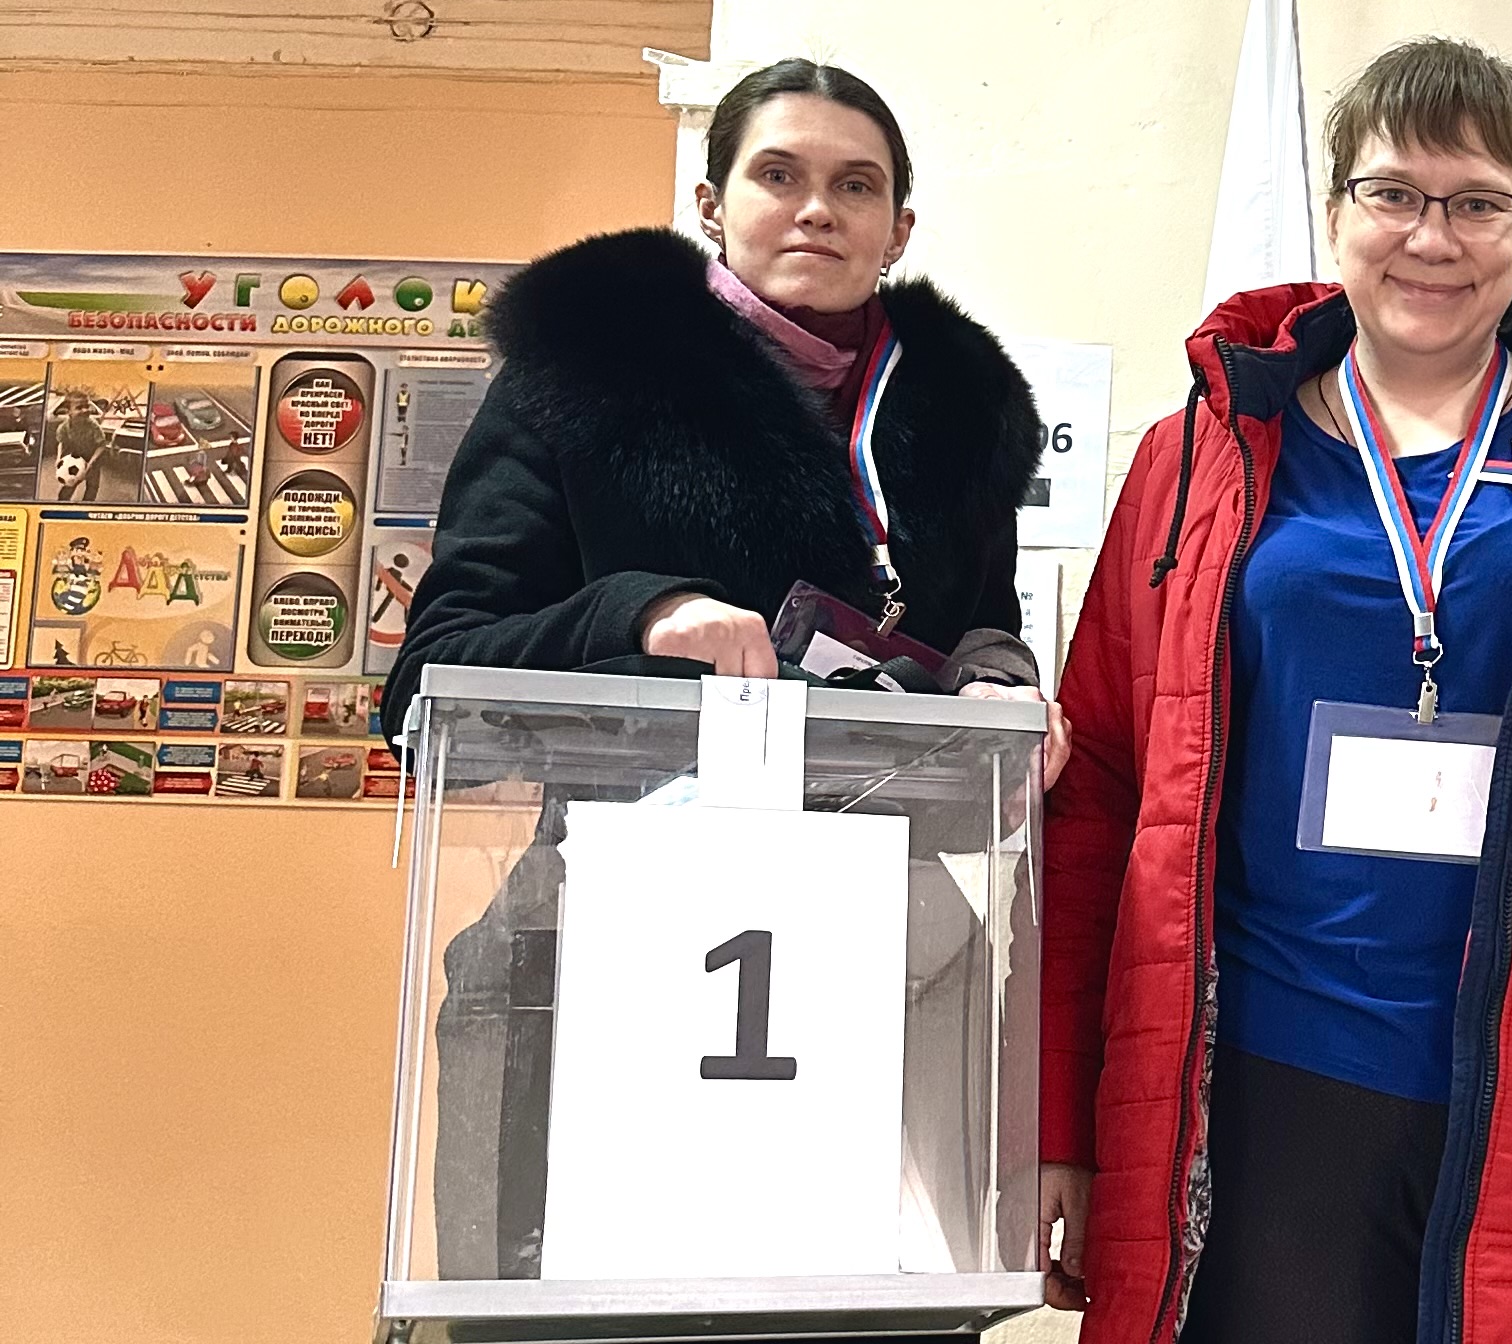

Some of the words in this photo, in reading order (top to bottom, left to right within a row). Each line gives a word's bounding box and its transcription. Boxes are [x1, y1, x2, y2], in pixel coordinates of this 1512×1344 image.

[178, 270, 488, 315] УГОЛОК
[67, 310, 257, 332] БЕЗОПАСНОСТИ
[271, 315, 434, 336] ДОРОЖНОГО
[304, 420, 334, 429] ДОРОГИ
[303, 432, 334, 446] НЕТ!
[280, 525, 341, 536] ДОЖДИСЬ!
[271, 630, 332, 644] ПЕРЕХОДИ
[699, 929, 797, 1080] 1
